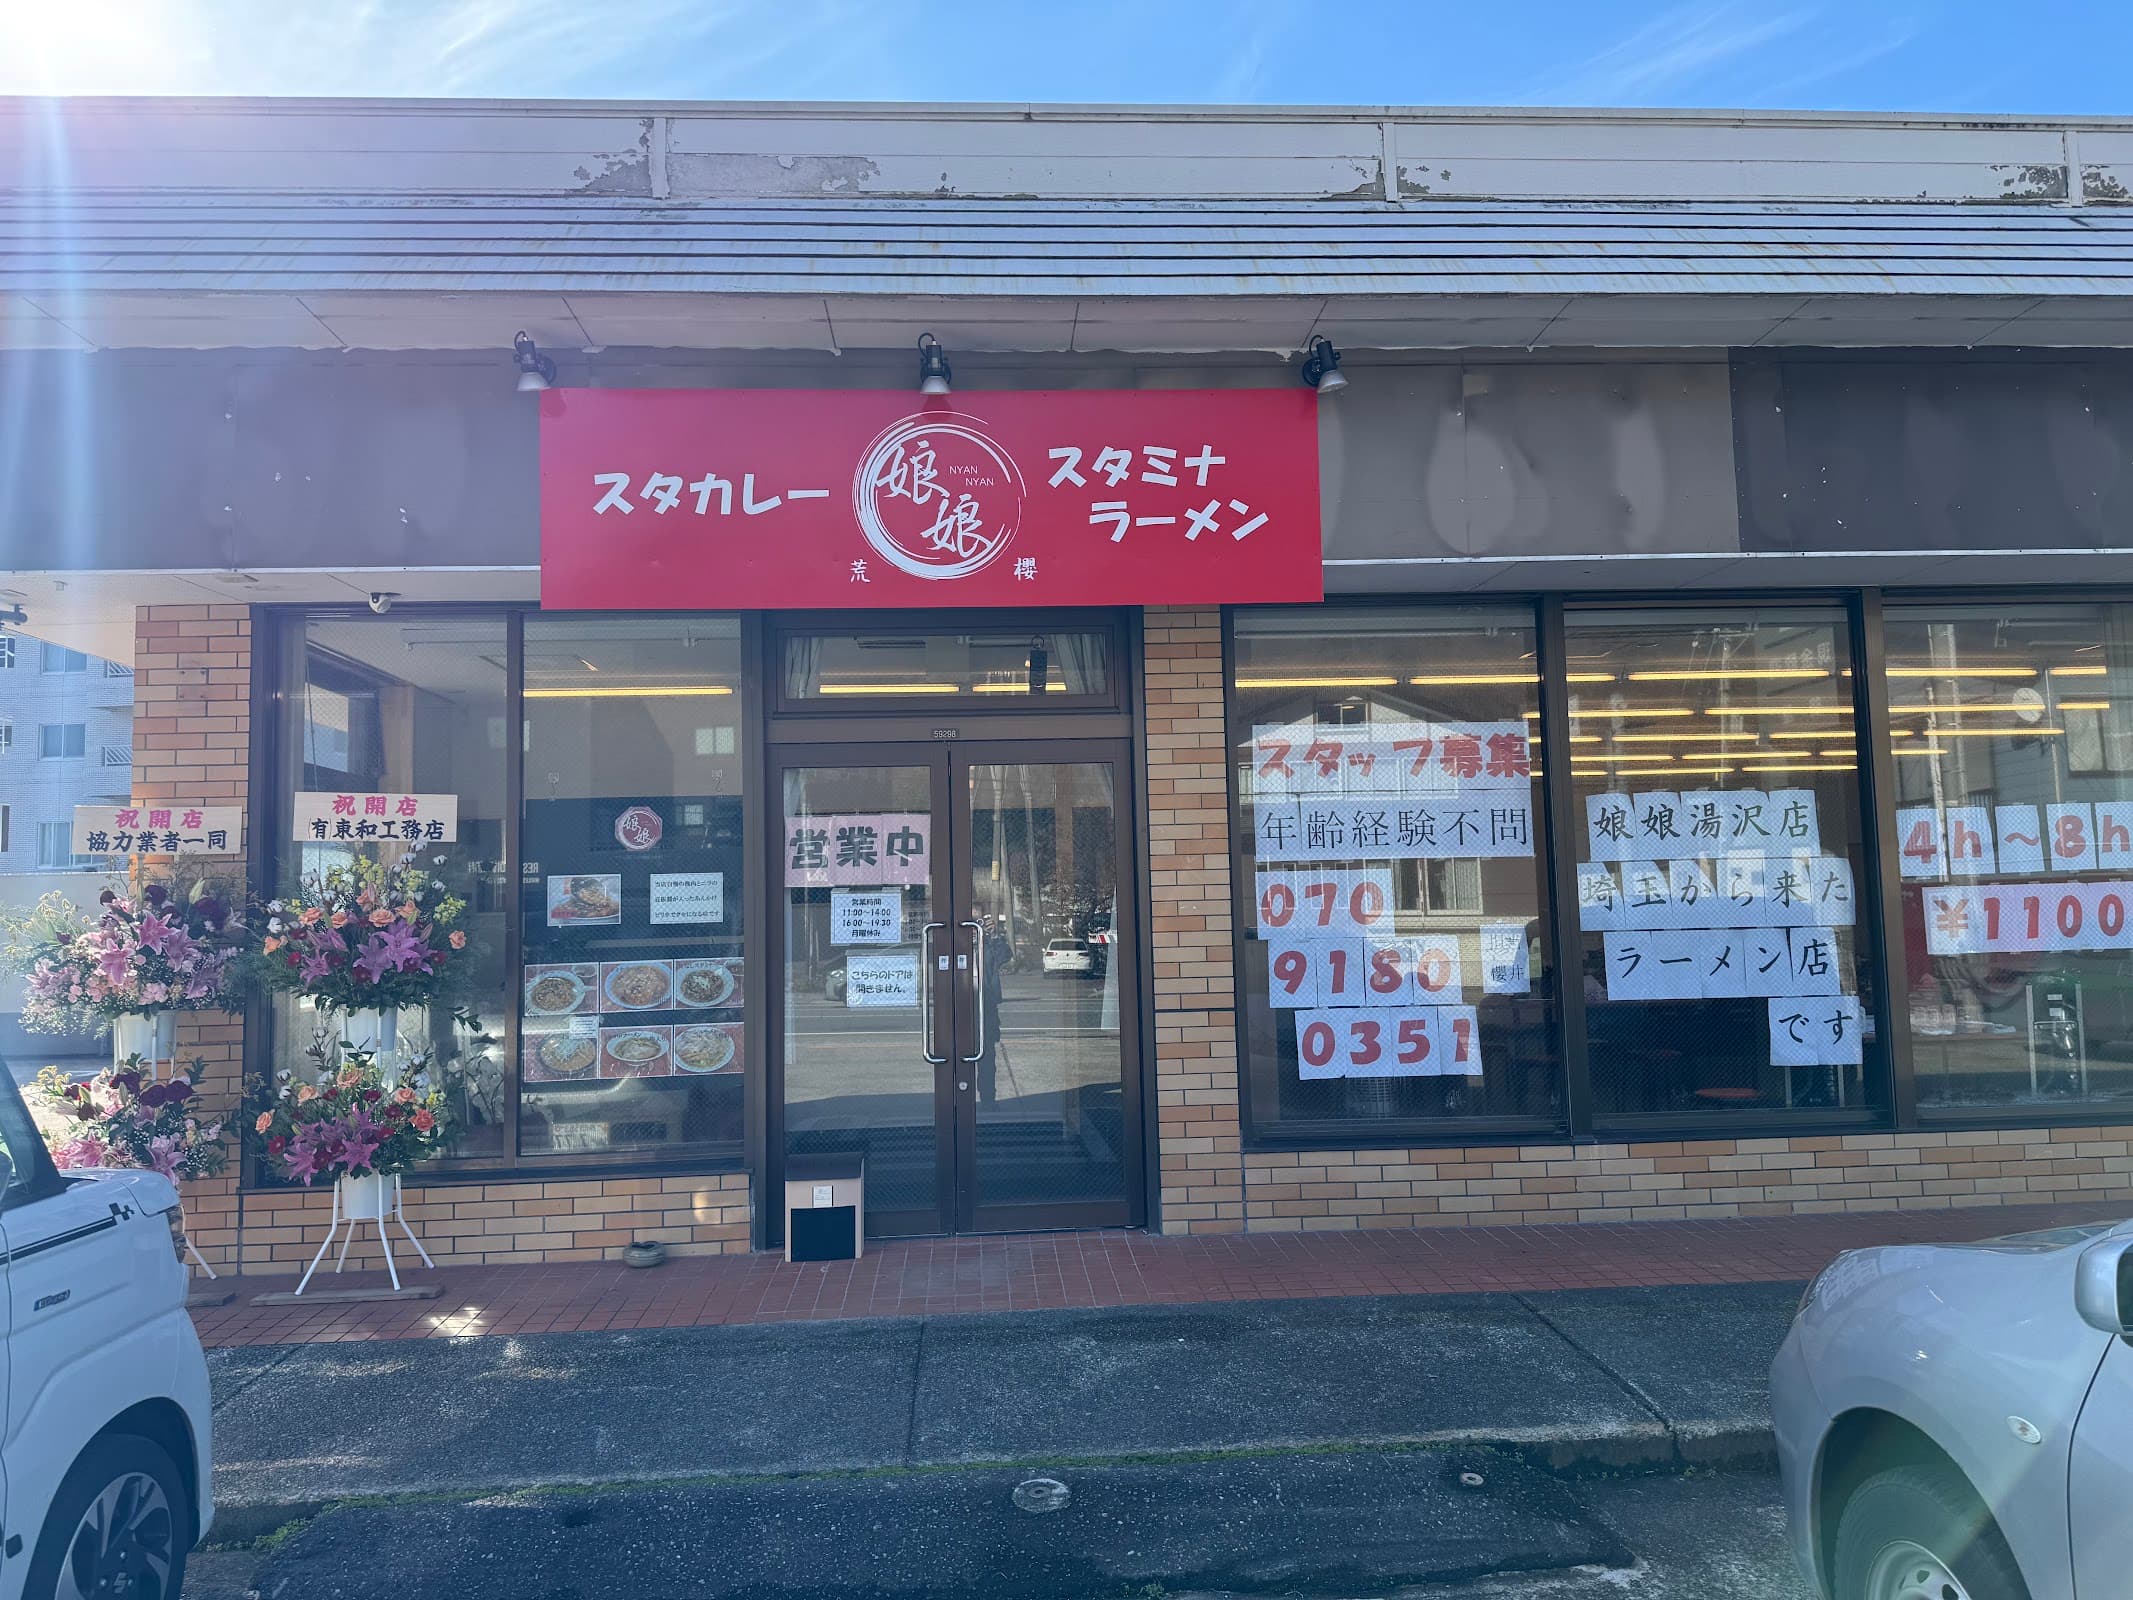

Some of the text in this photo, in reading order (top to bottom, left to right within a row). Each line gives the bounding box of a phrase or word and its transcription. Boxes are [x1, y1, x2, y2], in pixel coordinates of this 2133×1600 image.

[949, 465, 978, 475] NYAN
[965, 477, 994, 487] NYAN
[1048, 445, 1226, 488] スタミナ
[593, 472, 830, 515] スタカレー
[1089, 499, 1269, 542] ラーメン
[1257, 733, 1531, 779] スタッフ募集
[115, 808, 204, 830] 祝開店
[331, 795, 418, 817] 祝開店
[1592, 800, 1809, 841] 娘娘湯沢店
[86, 830, 227, 853] 協力業者一同
[789, 825, 924, 870] 営業中
[1260, 808, 1527, 849] 年齢経験不問
[1260, 881, 1384, 928] 070
[1583, 870, 1848, 912] 埼玉から来た
[1933, 893, 2125, 940] ¥1100
[851, 970, 913, 980] こちらのドアは
[1273, 948, 1451, 995] 9180
[1617, 939, 1829, 978] ラーメン店
[1302, 1018, 1471, 1067] 0351
[1778, 1010, 1852, 1044] です
